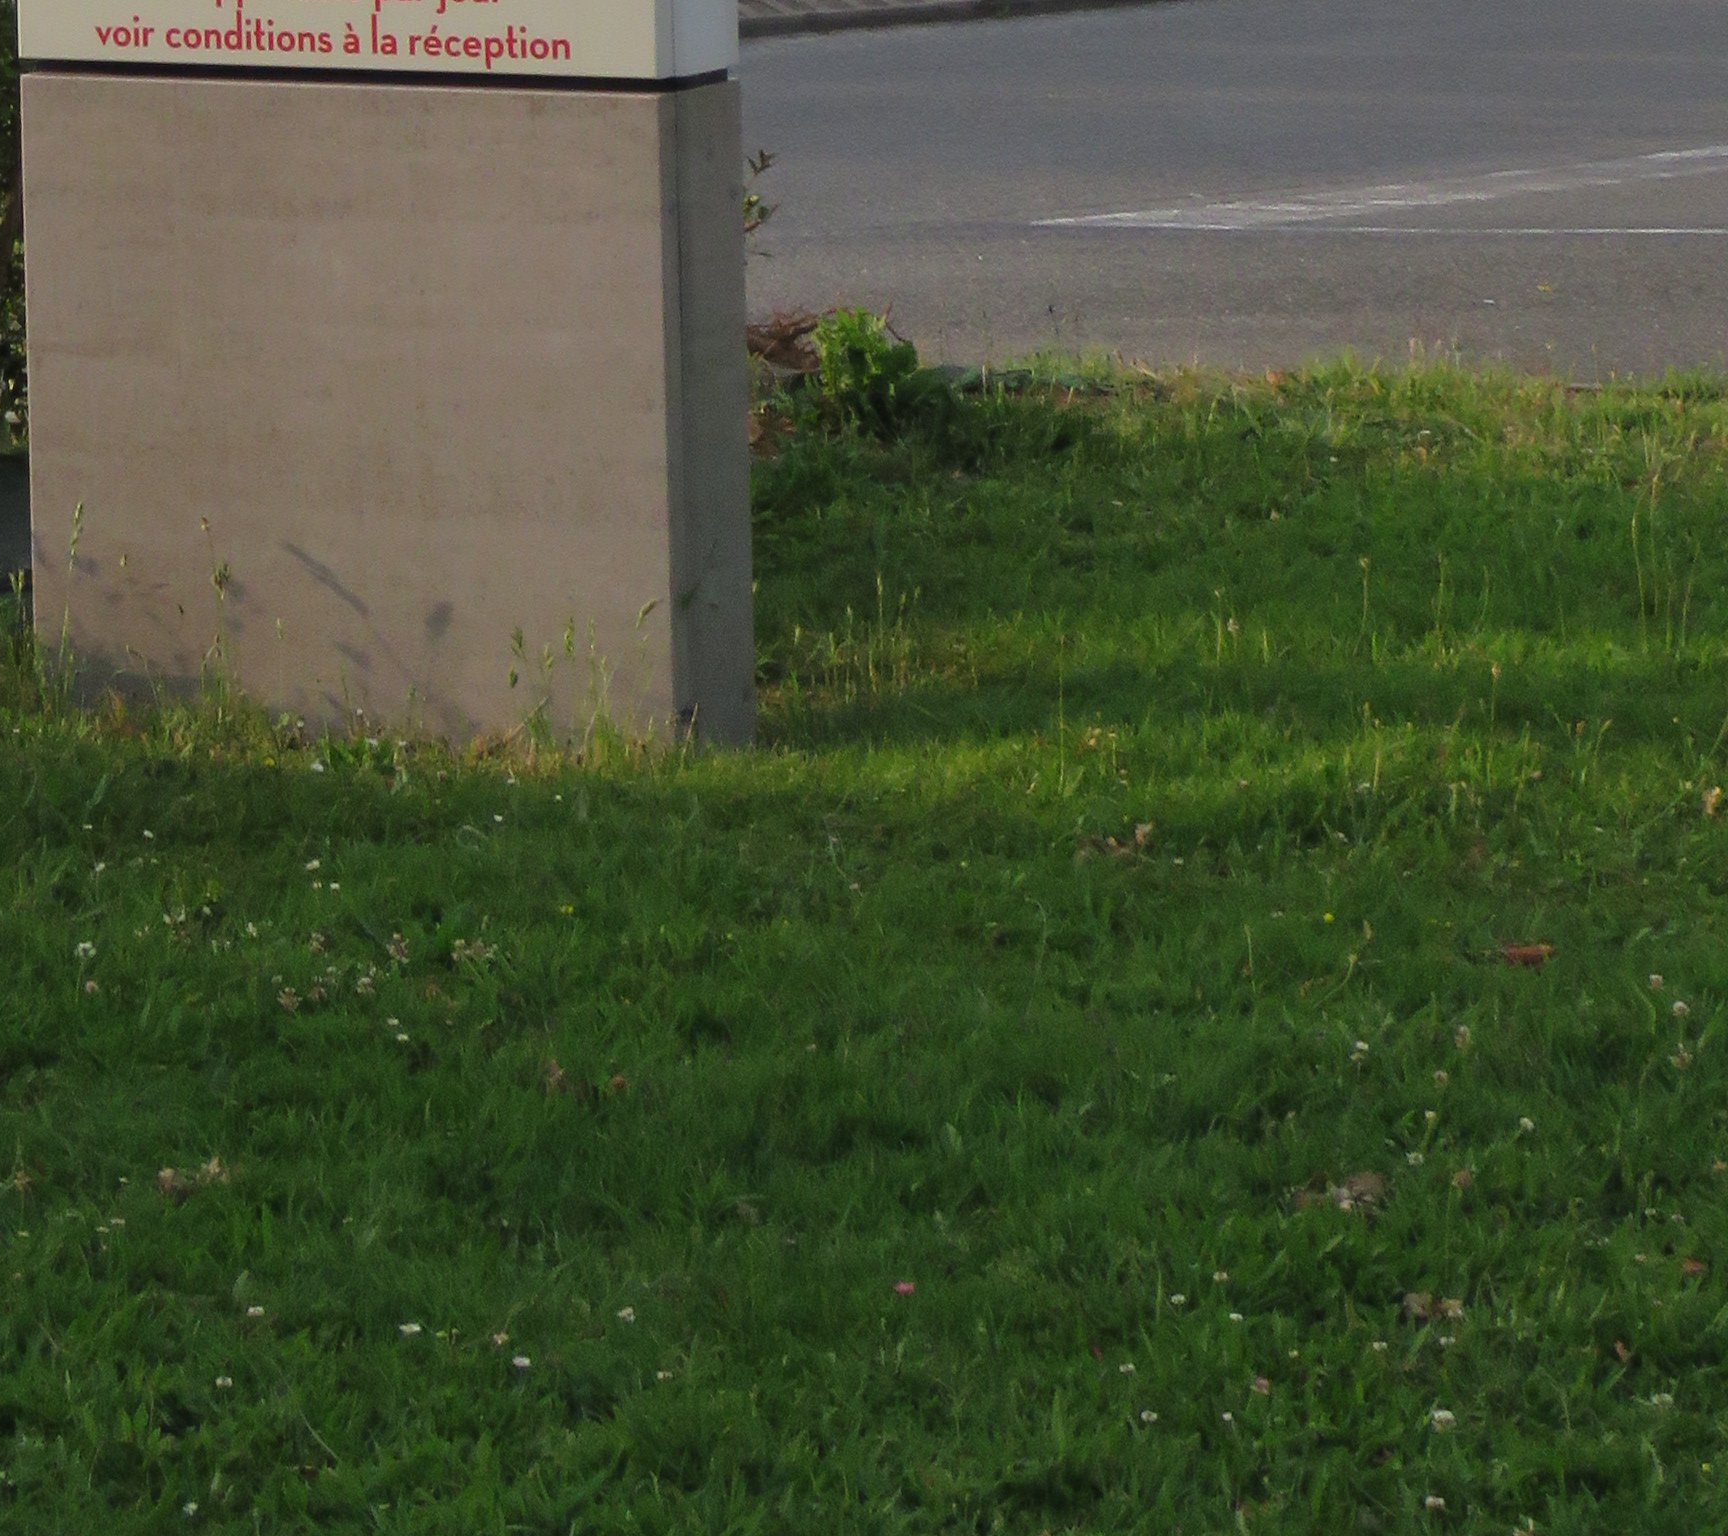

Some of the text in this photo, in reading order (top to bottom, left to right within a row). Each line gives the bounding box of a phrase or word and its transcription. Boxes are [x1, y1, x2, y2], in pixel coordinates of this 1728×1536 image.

[94, 9, 572, 71] voir conditions à la réception
